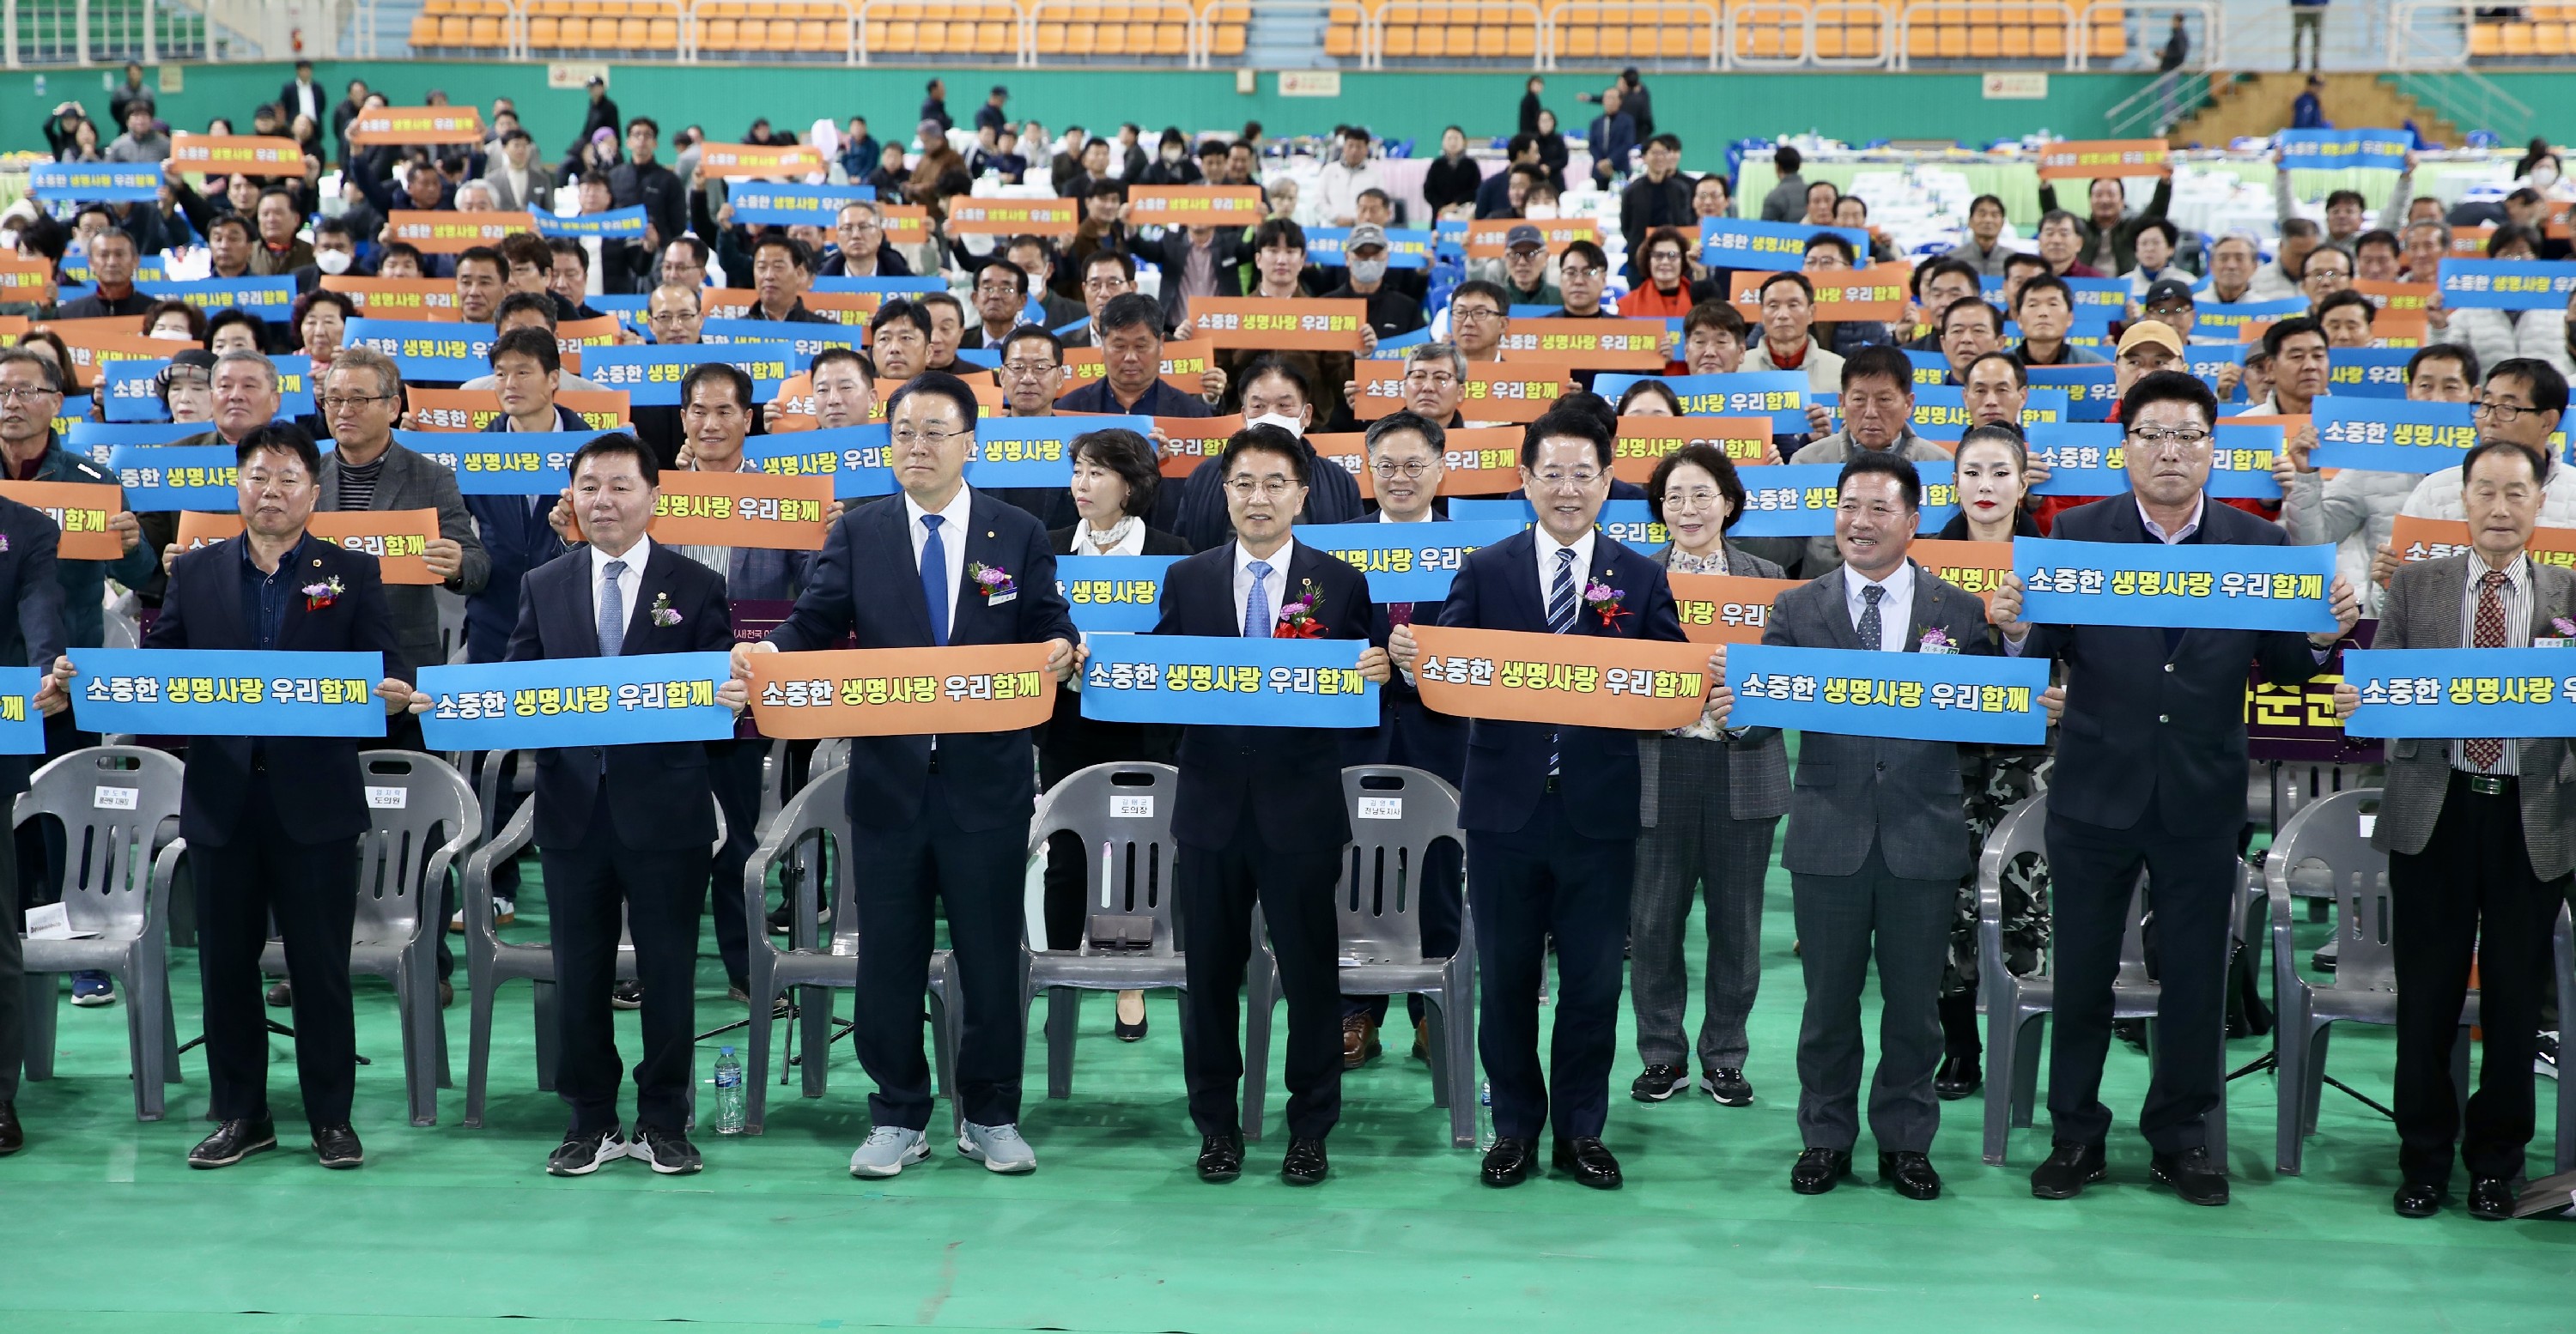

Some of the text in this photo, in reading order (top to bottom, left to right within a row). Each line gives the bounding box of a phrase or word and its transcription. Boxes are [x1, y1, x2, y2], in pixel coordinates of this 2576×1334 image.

[1708, 233, 1806, 255] 소중한 생명사랑
[0, 272, 43, 288] 리함께
[138, 268, 161, 281] 함께
[2445, 276, 2489, 290] 소중한
[2494, 277, 2550, 292] 생명사랑
[1815, 286, 1900, 302] 사랑 우리함께
[1982, 289, 2005, 302] 소중
[1198, 314, 1356, 330] 소중한 생명사랑 우리함께
[403, 340, 466, 358] 생명사랑
[1542, 334, 1597, 349] 생명사랑
[1601, 335, 1656, 349] 우리함께
[592, 366, 642, 384] 소중한
[1078, 359, 1204, 378] 생명 리함께
[1913, 369, 1949, 385] 생명
[2330, 367, 2365, 383] 사랑
[1492, 381, 1558, 398] 우리함께
[1730, 391, 1800, 412] 우리함께
[417, 409, 618, 429] 소중한 함께
[2022, 409, 2057, 427] 함께
[2324, 420, 2476, 449] 소중한 생명사랑
[984, 440, 1062, 461] 생명사랑
[1169, 438, 1229, 456] 우리함
[463, 452, 540, 472] 생명사랑
[1445, 449, 1515, 470] 우리함께
[2041, 446, 2273, 471] 소중한 리함께
[119, 469, 160, 488] 중한
[738, 497, 819, 522] 우리함께
[1743, 488, 1838, 511] 소중한 생명
[1608, 523, 1671, 543] 우리함
[1071, 580, 1156, 603] 생명사랑
[2028, 567, 2323, 599] 소중한 생명사랑 우리함께
[1089, 662, 1364, 695] 소중한 생명사랑 우리함께
[1421, 655, 1703, 699] 소중한 생명사랑 우리함께
[86, 676, 368, 706] 소중한 생명사랑 우리함께
[762, 670, 1041, 706] 소중한 생명사랑 우리함께
[1741, 674, 2030, 715] 소중한 생명사랑 우리함께
[2362, 678, 2441, 706] 소중한
[2447, 677, 2555, 705] 생명사랑
[435, 679, 714, 719] 소중한 생명사랑 우리함께
[1121, 806, 1147, 815] 도의장
[1364, 807, 1400, 816] 전남도지사
